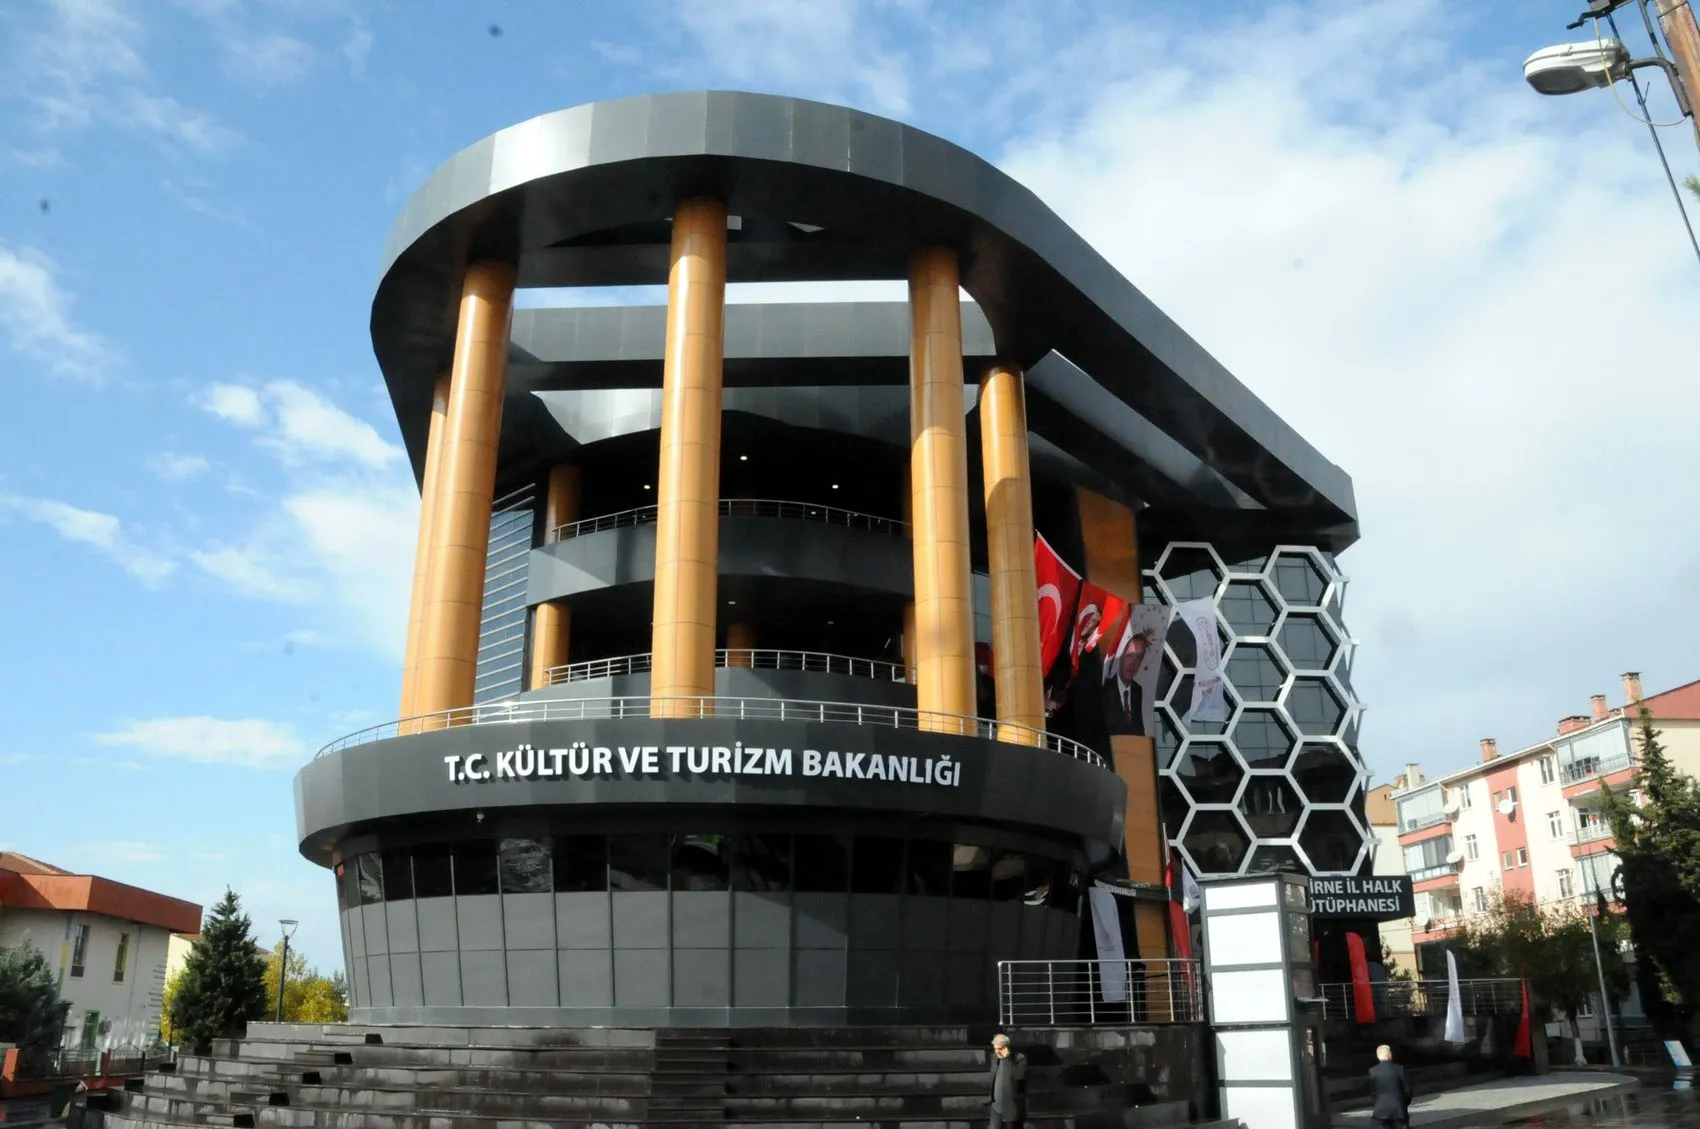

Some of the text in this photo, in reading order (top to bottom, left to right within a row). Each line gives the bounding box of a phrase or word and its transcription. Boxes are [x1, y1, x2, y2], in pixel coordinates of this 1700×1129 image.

[444, 741, 961, 786] T.C. KÜLTÜR VE TURİZM BAKANLIĞI
[1309, 878, 1402, 894] İRNE İL HALK
[1310, 896, 1400, 913] TÜPHANESİ
